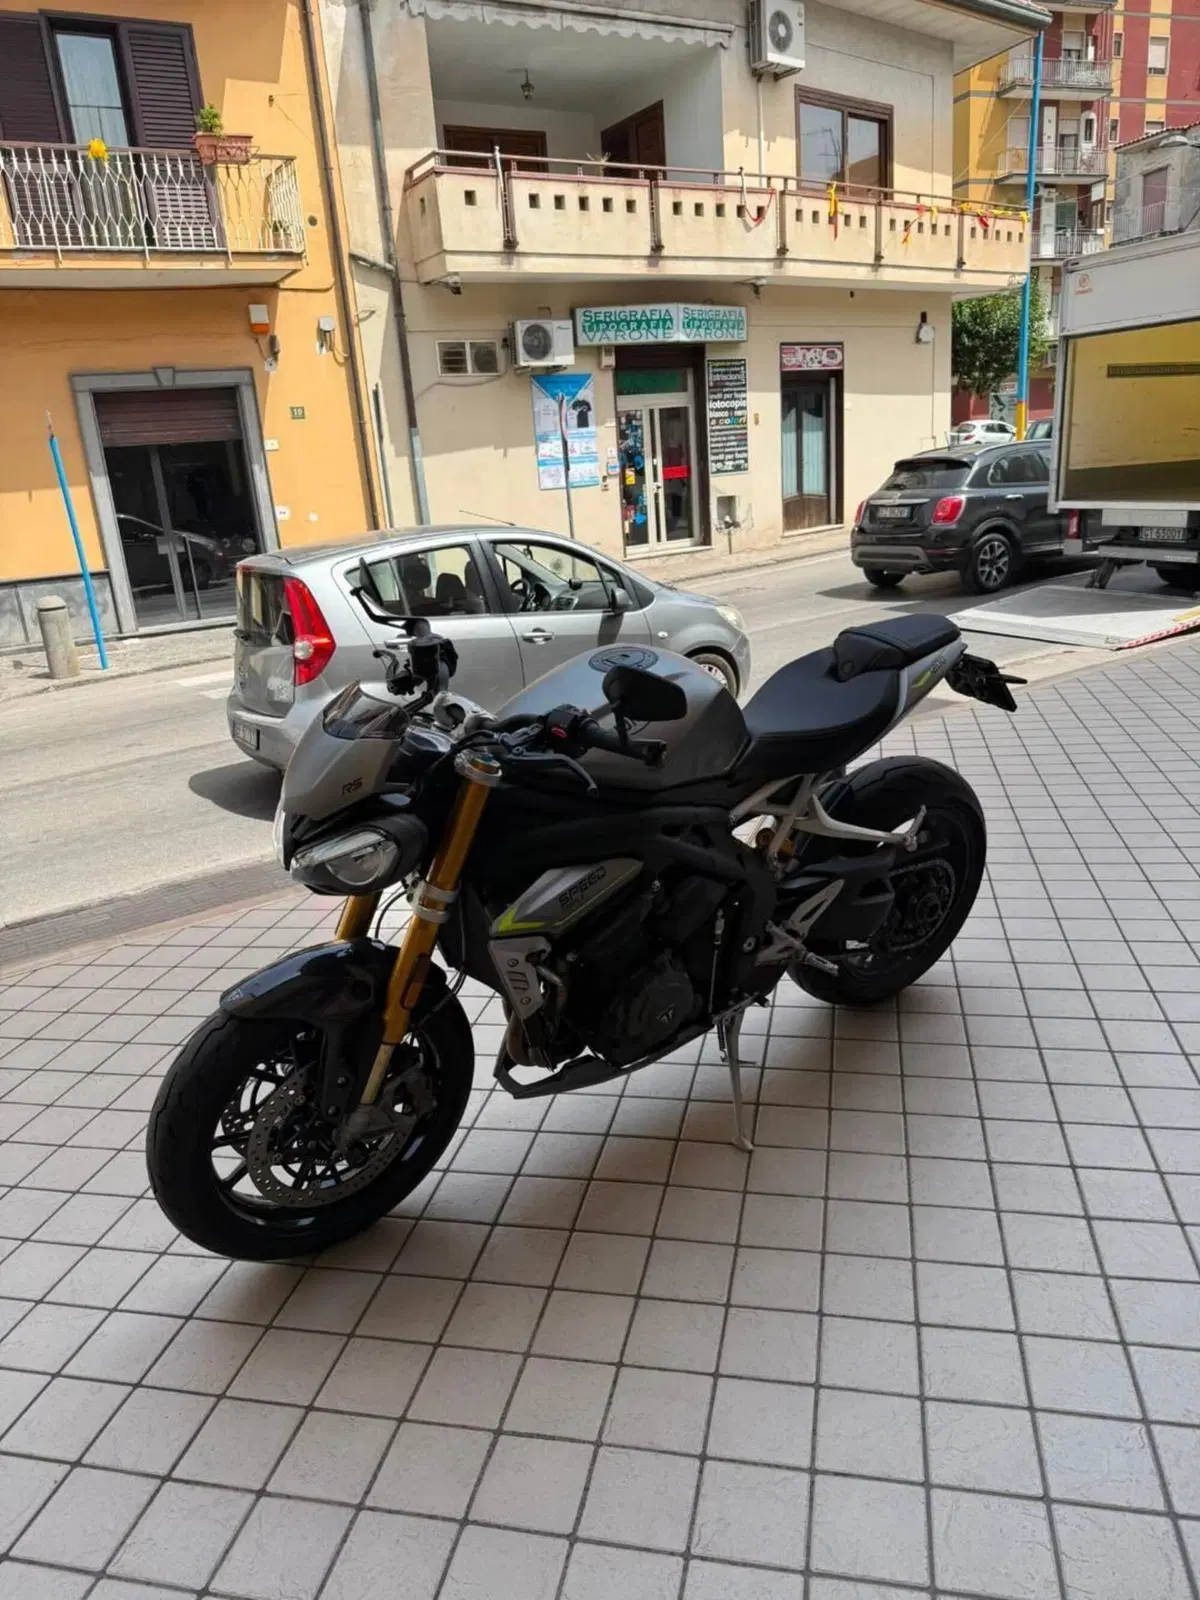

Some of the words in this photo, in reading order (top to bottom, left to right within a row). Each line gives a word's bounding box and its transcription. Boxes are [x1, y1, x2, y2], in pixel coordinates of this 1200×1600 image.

[582, 309, 672, 322] SERIGRAFIA
[683, 307, 744, 319] SERIGRAFIA
[583, 320, 673, 332] TIPOGRAFIA
[683, 318, 744, 330] TIPOGRAFIA
[584, 330, 673, 342] VARONE
[685, 328, 745, 340] VARONE
[292, 408, 303, 416] 10
[342, 777, 363, 796] RS
[559, 865, 606, 908] SPEED
